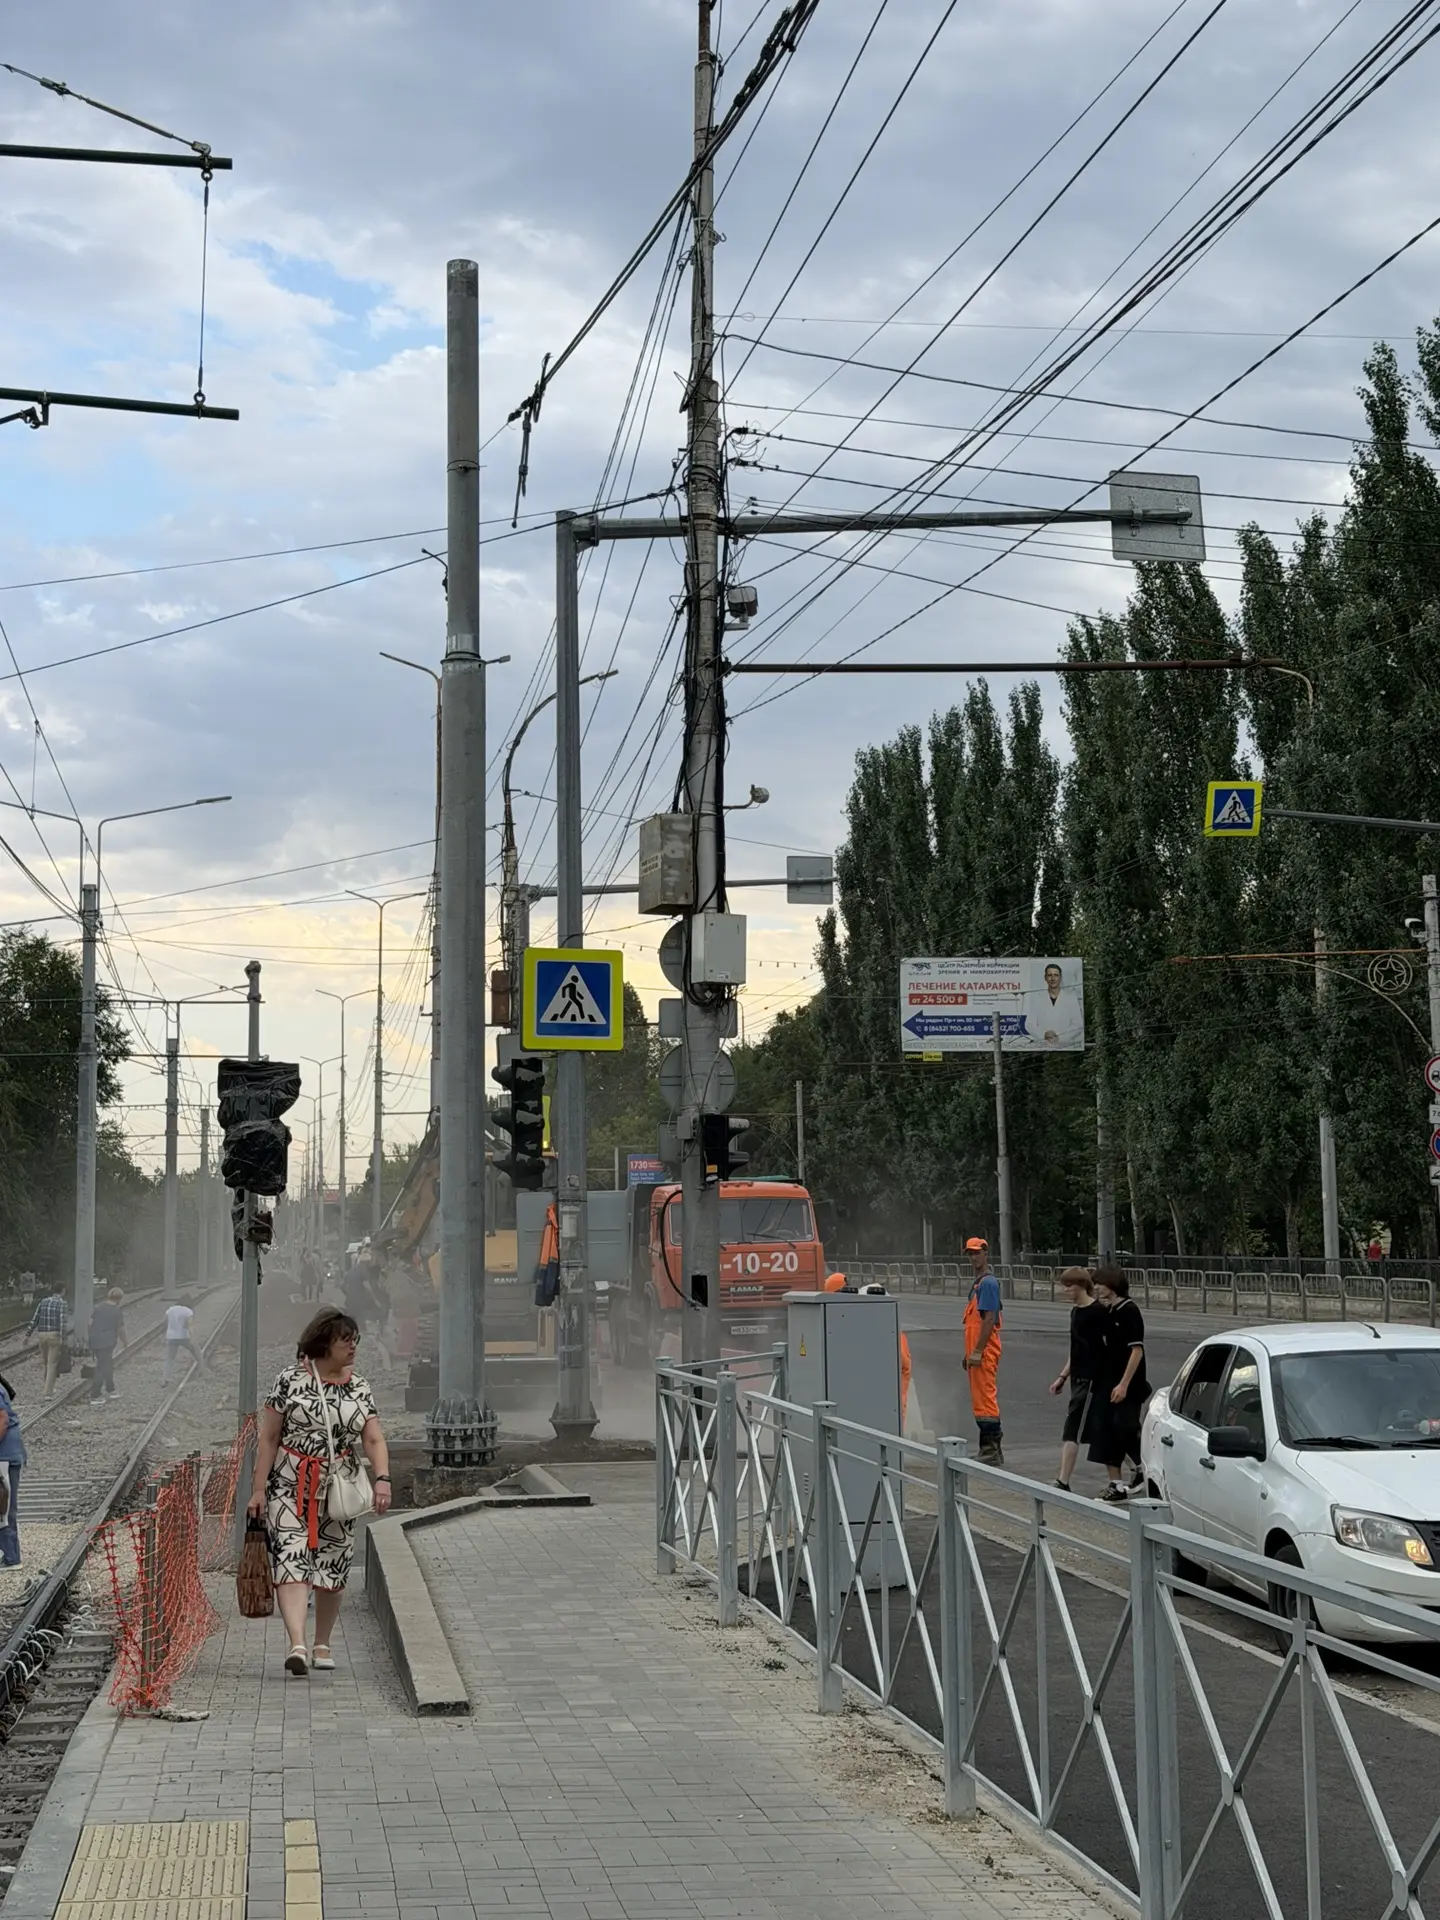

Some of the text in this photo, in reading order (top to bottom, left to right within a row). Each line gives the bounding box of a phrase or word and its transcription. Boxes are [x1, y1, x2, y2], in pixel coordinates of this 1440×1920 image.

[908, 982, 1021, 991] ЛЕЧЕНИЕ КАТАРАКТЫ
[922, 995, 934, 1004] 24
[935, 995, 956, 1004] 500
[630, 1160, 648, 1170] 1730
[729, 1285, 764, 1293] KAMAZ
